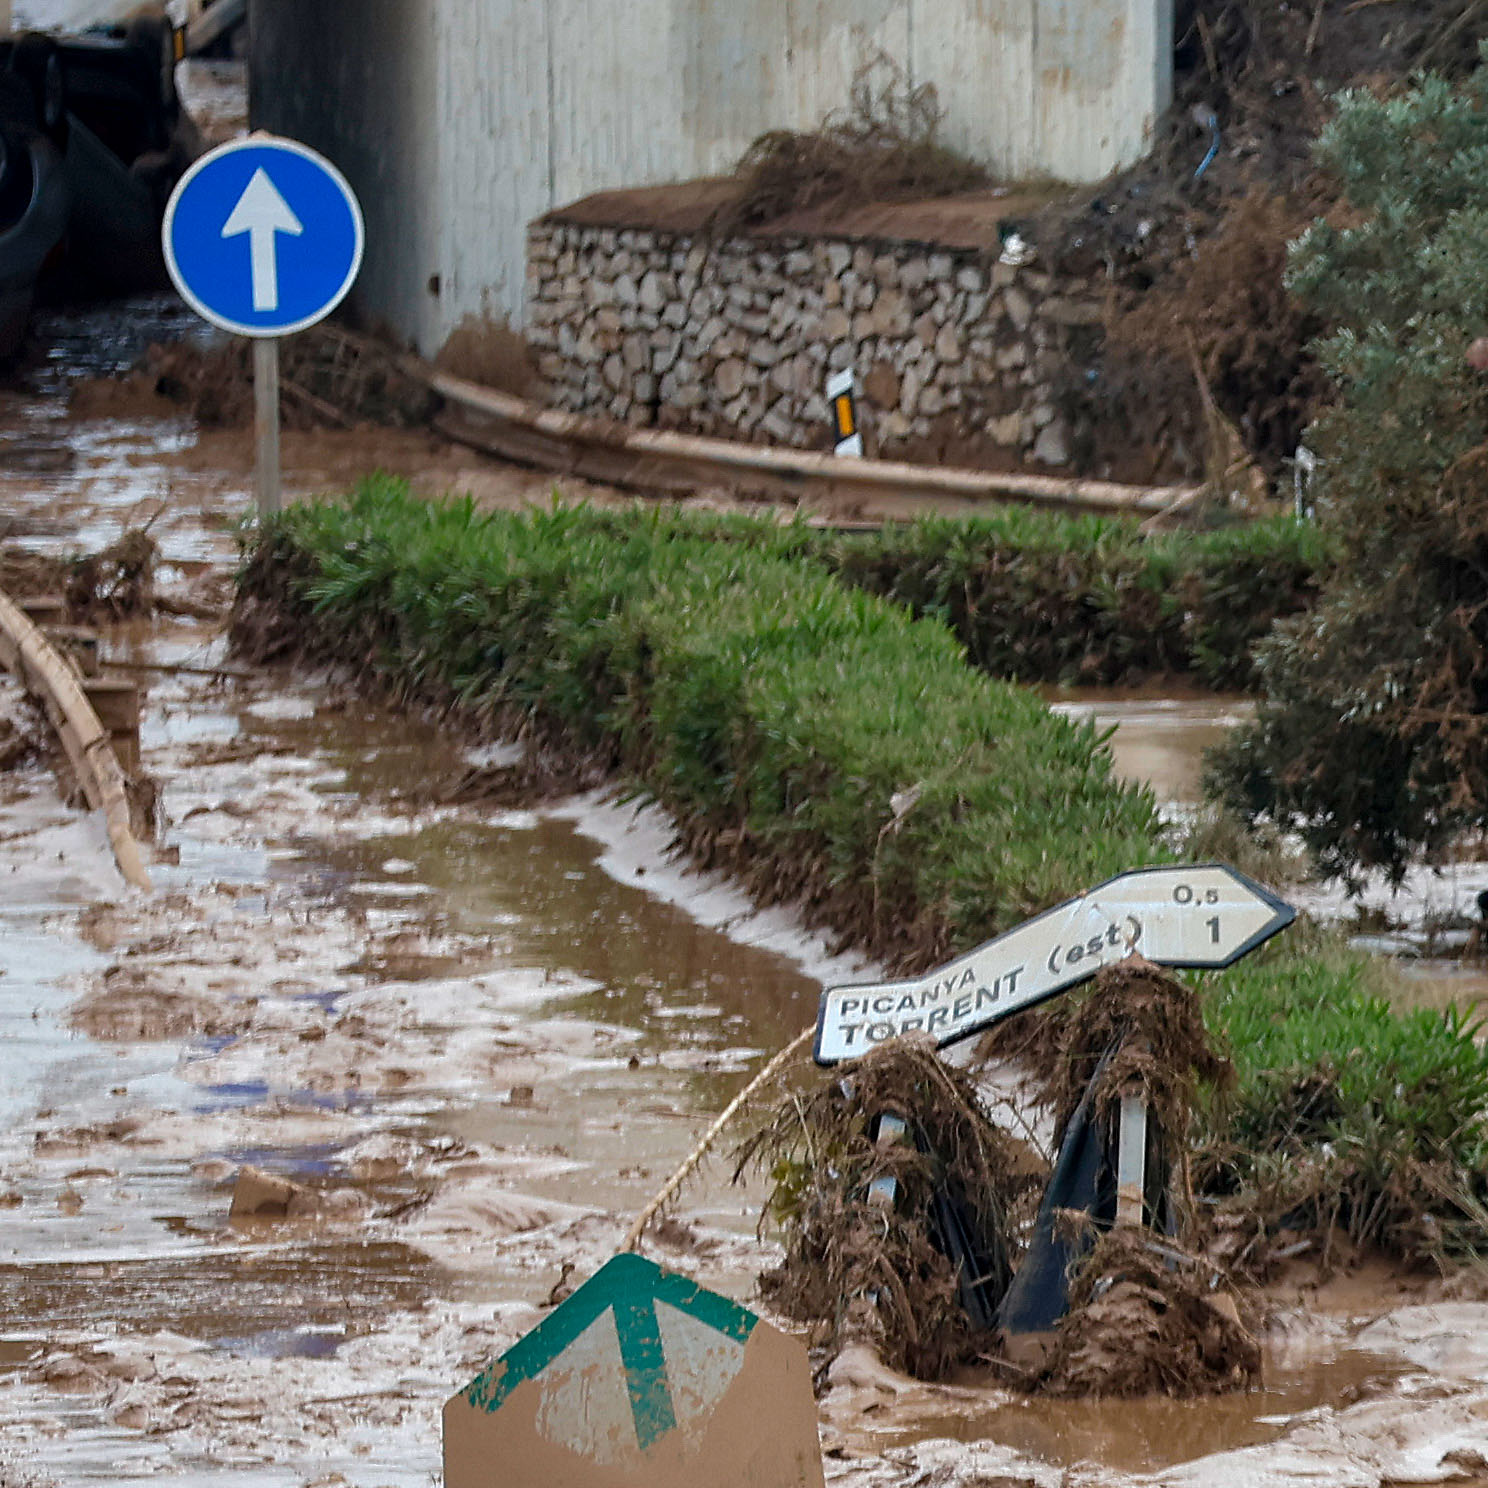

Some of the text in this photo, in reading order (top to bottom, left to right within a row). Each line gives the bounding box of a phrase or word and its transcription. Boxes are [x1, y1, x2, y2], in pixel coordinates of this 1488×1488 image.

[840, 885, 1219, 1017] PICANYA 0,5
[1047, 914, 1143, 974] (est)
[1206, 915, 1220, 943] 1
